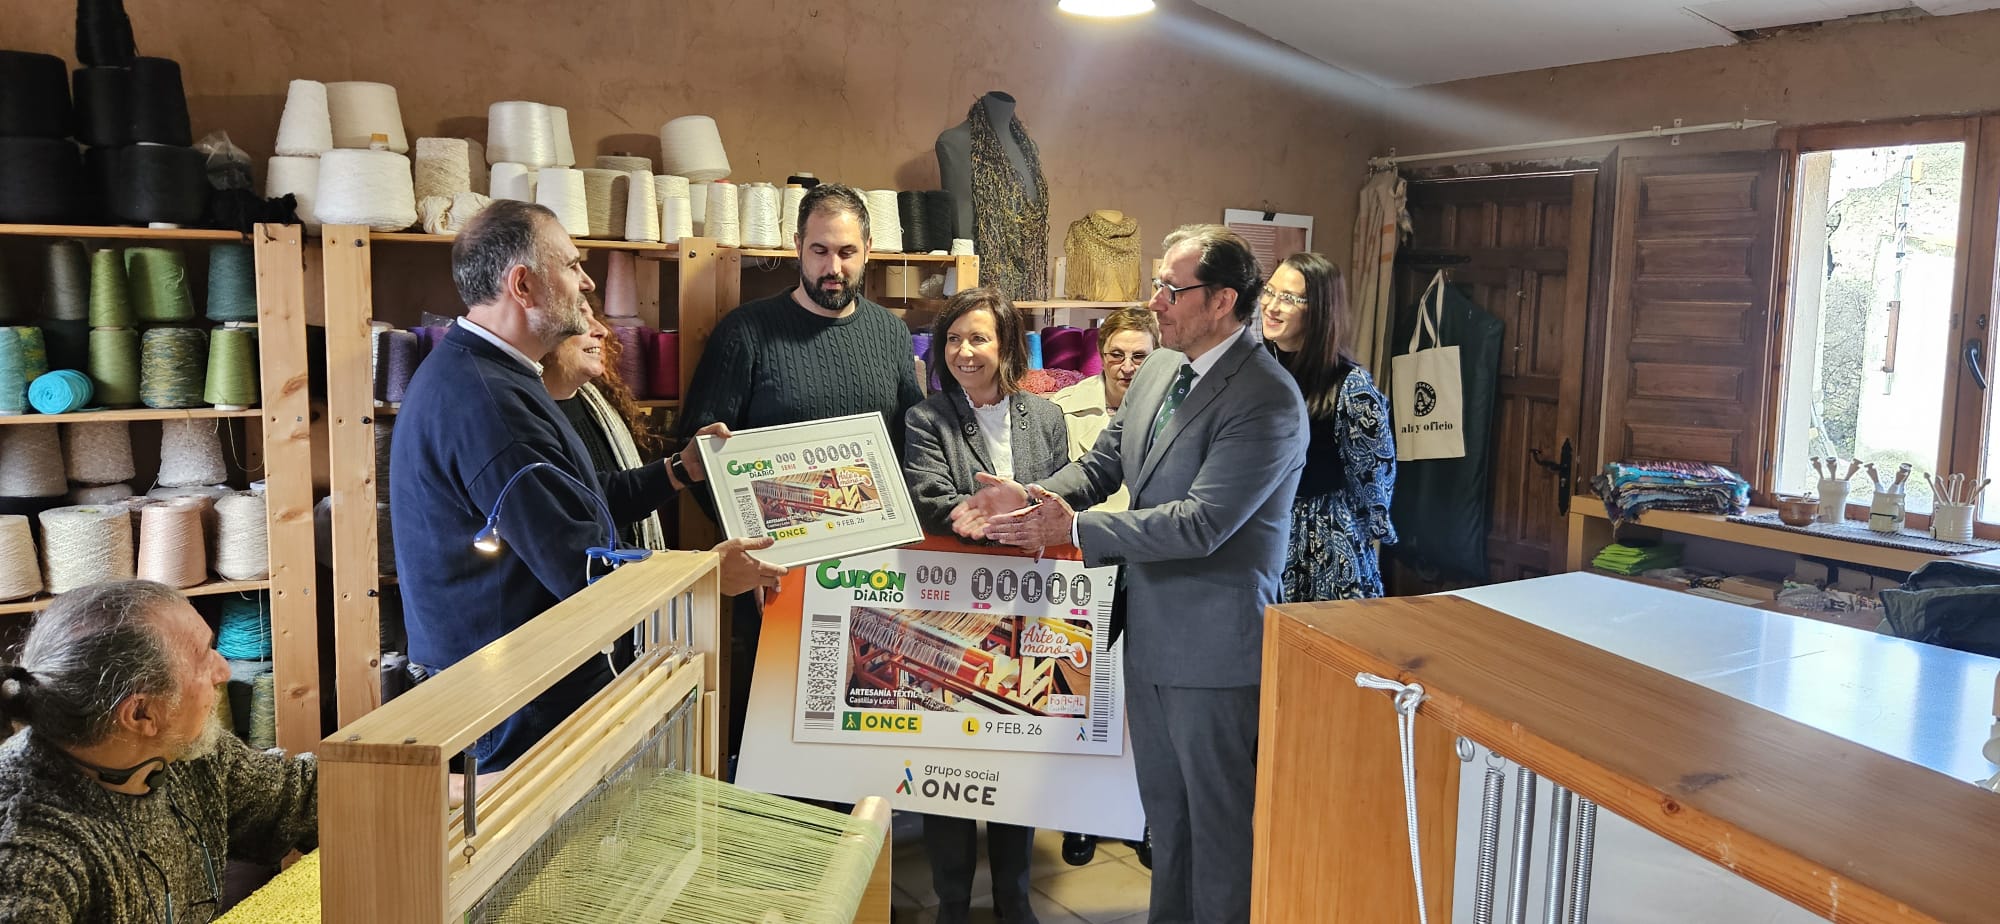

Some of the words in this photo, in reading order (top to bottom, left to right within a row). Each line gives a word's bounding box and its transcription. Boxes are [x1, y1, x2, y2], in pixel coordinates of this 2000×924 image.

[1423, 420, 1453, 431] oficio
[776, 452, 796, 463] 000
[802, 441, 863, 465] 00000
[779, 527, 806, 538] ONCE
[916, 565, 957, 585] 000
[970, 567, 1092, 607] 00000
[920, 589, 950, 600] SERIE
[1023, 624, 1053, 643] Arte
[1056, 635, 1065, 643] a
[1022, 644, 1063, 654] mano
[849, 687, 892, 697] ARTESANÍA
[849, 696, 874, 704] Castilla
[879, 697, 895, 705] León
[865, 715, 918, 731] ONCE
[967, 720, 975, 732] L
[985, 721, 993, 733] 9
[997, 722, 1025, 735] FEB.
[1027, 723, 1043, 735] 26
[924, 764, 962, 777] grupo
[965, 769, 1000, 782] social
[922, 778, 997, 806] ONCE
